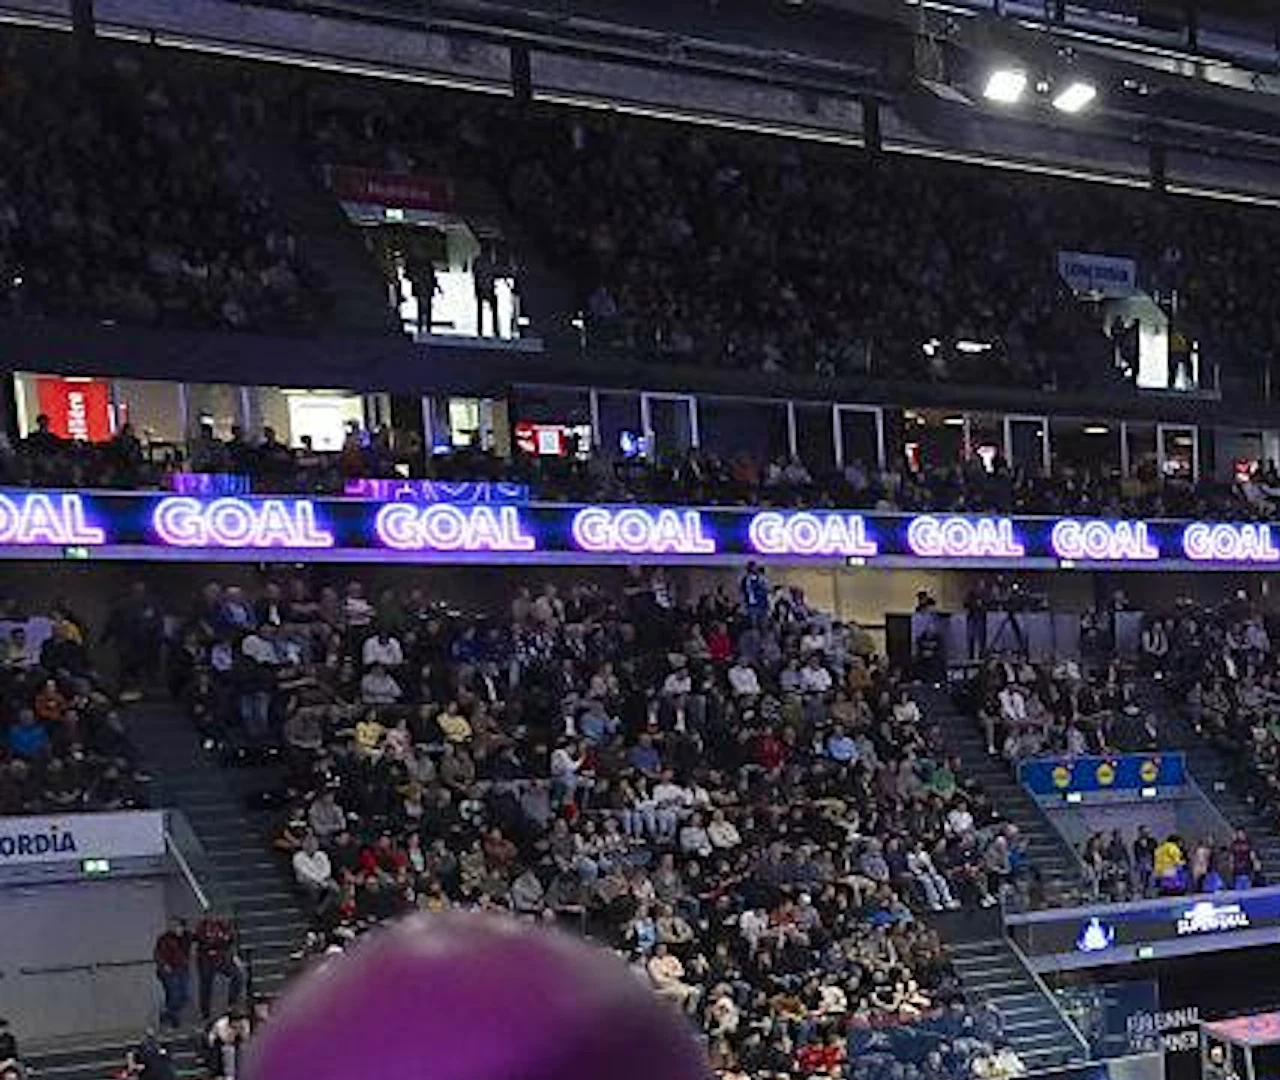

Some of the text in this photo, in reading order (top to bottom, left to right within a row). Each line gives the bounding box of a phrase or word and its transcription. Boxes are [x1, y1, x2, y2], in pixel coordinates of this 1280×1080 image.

[153, 498, 334, 548] GOAL
[375, 503, 536, 551] GOAL
[572, 507, 716, 555] GOAL
[748, 511, 878, 556] GOAL
[906, 515, 1025, 558] GOAL
[1050, 520, 1160, 560] GOAL
[1182, 522, 1280, 561] GOAL
